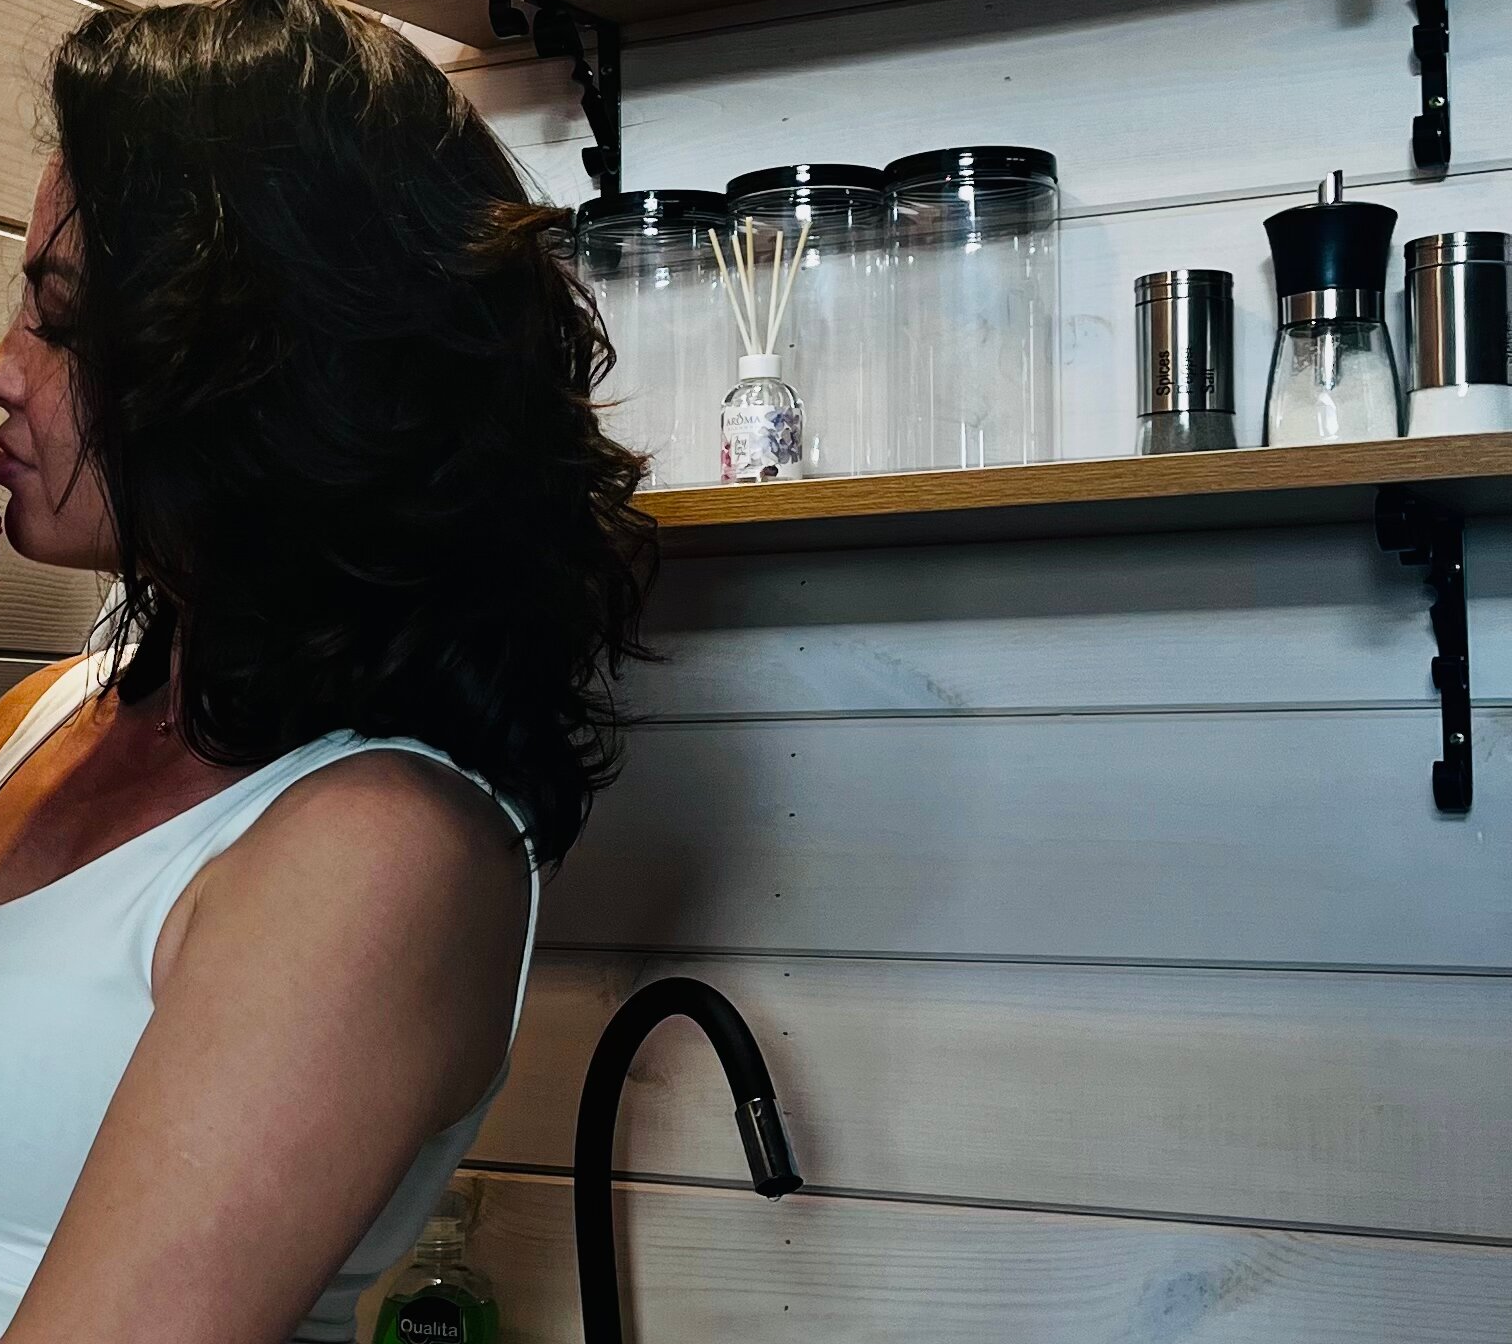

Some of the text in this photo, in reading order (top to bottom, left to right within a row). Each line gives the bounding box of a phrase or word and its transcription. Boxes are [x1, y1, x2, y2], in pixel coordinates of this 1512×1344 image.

[1156, 350, 1174, 396] Spices
[1202, 367, 1215, 394] Salt
[726, 413, 761, 426] AROMA
[400, 1318, 458, 1339] Qualita
